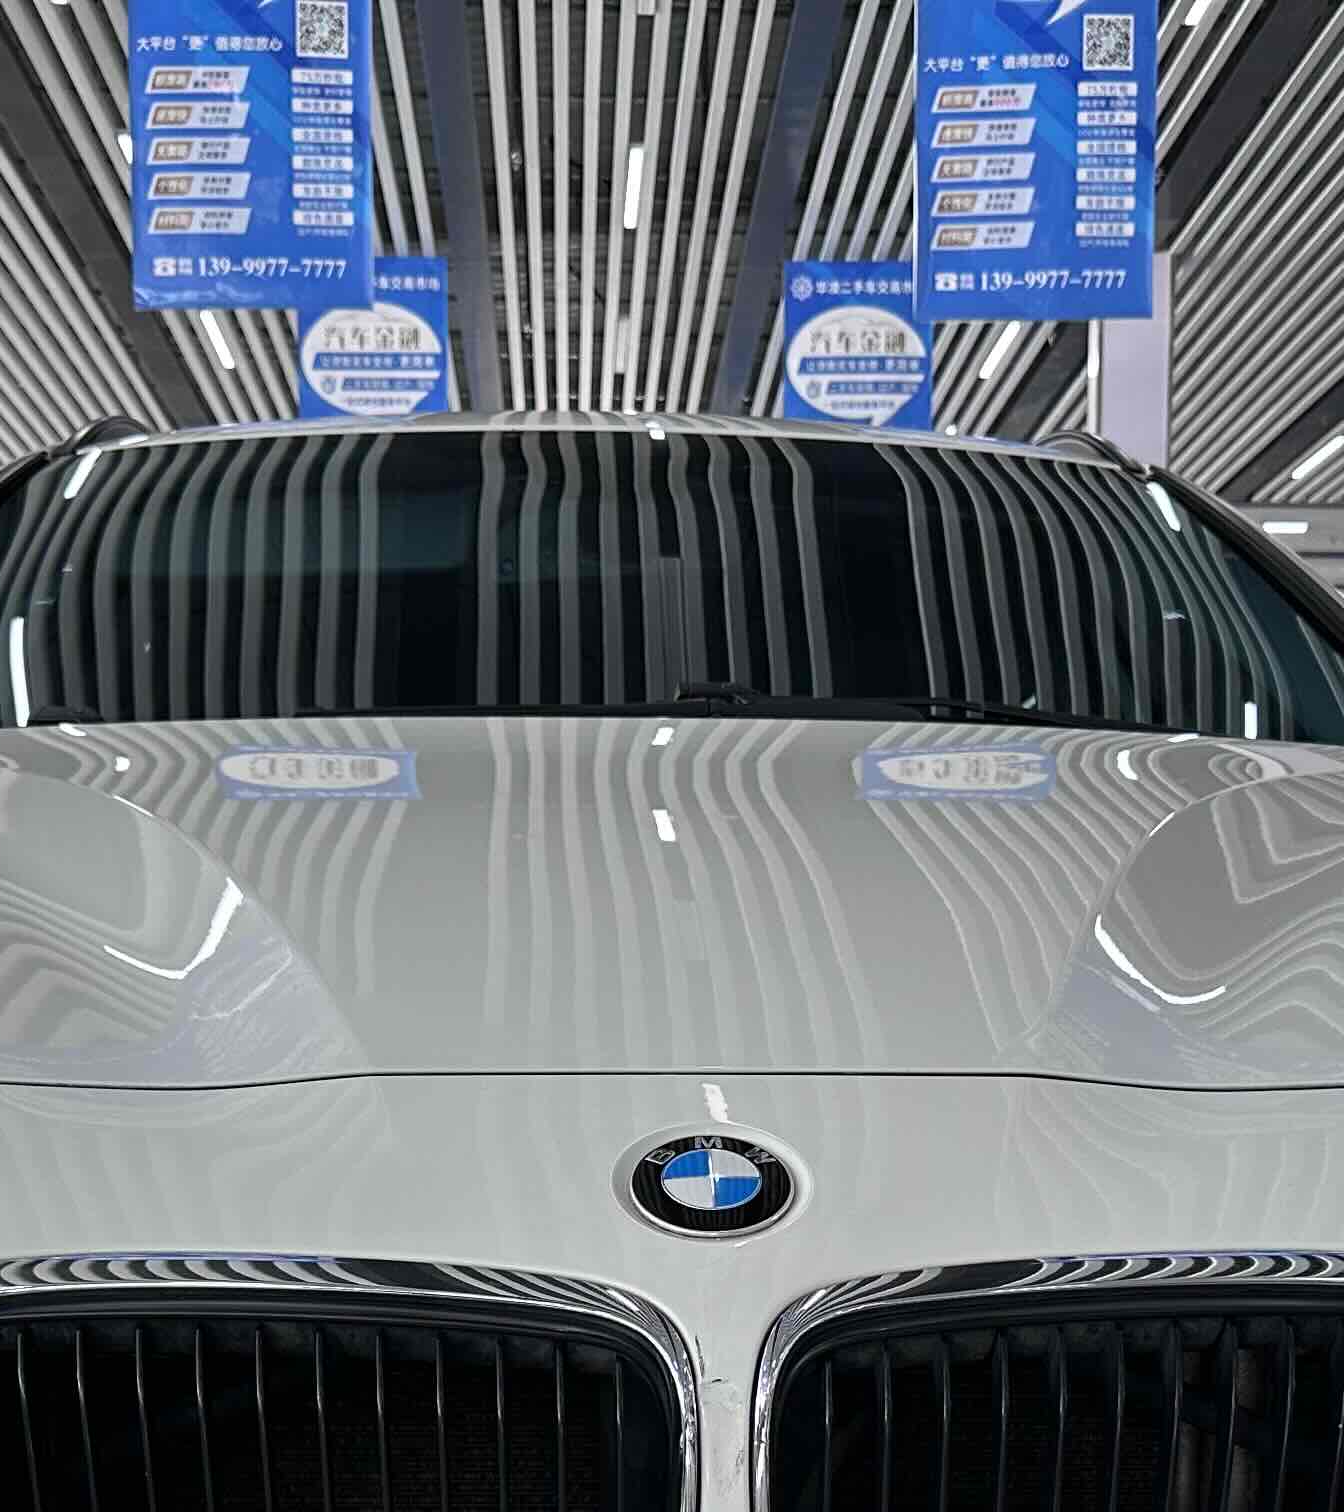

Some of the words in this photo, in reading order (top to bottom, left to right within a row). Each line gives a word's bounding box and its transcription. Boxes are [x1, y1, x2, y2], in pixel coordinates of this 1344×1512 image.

[198, 256, 348, 279] 139-9977-7777
[980, 269, 1127, 291] 139-9977-7777
[644, 1136, 777, 1165] BMW
